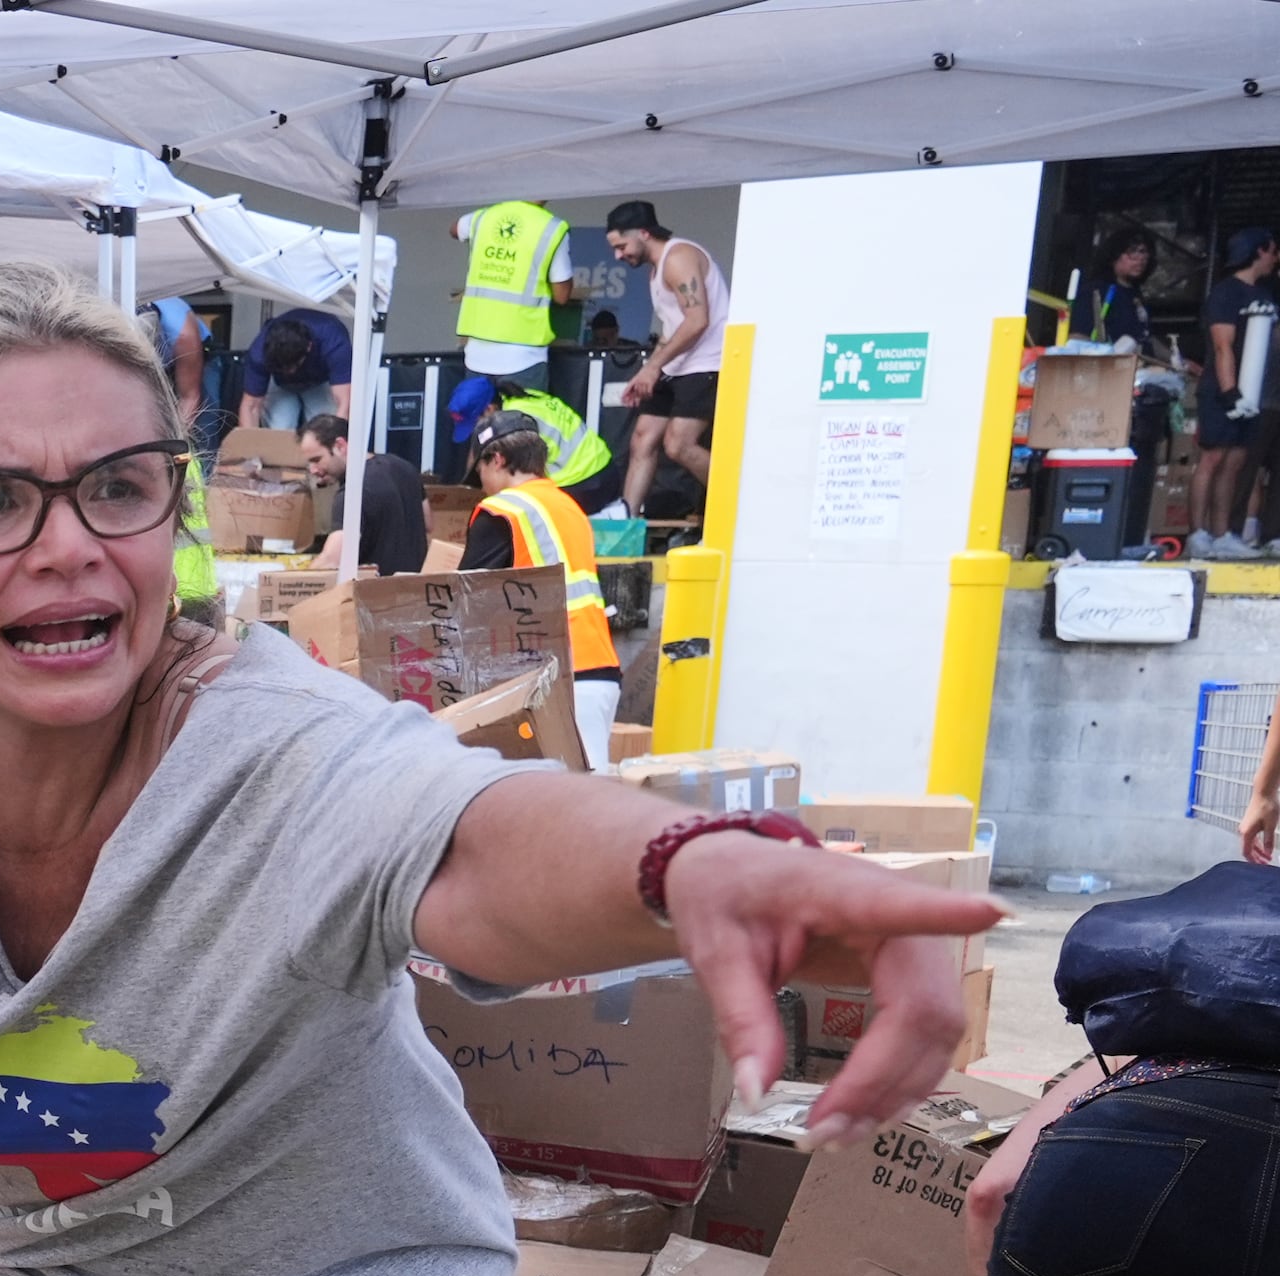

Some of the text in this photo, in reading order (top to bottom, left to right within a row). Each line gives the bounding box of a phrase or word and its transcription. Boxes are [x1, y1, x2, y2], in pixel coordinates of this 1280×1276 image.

[485, 247, 517, 262] GEM
[874, 348, 927, 359] EVACUATION
[877, 361, 922, 371] ASSEMBLY
[885, 373, 911, 384] POINT
[540, 1144, 563, 1161] 15"
[873, 1165, 964, 1217] bags of 18
